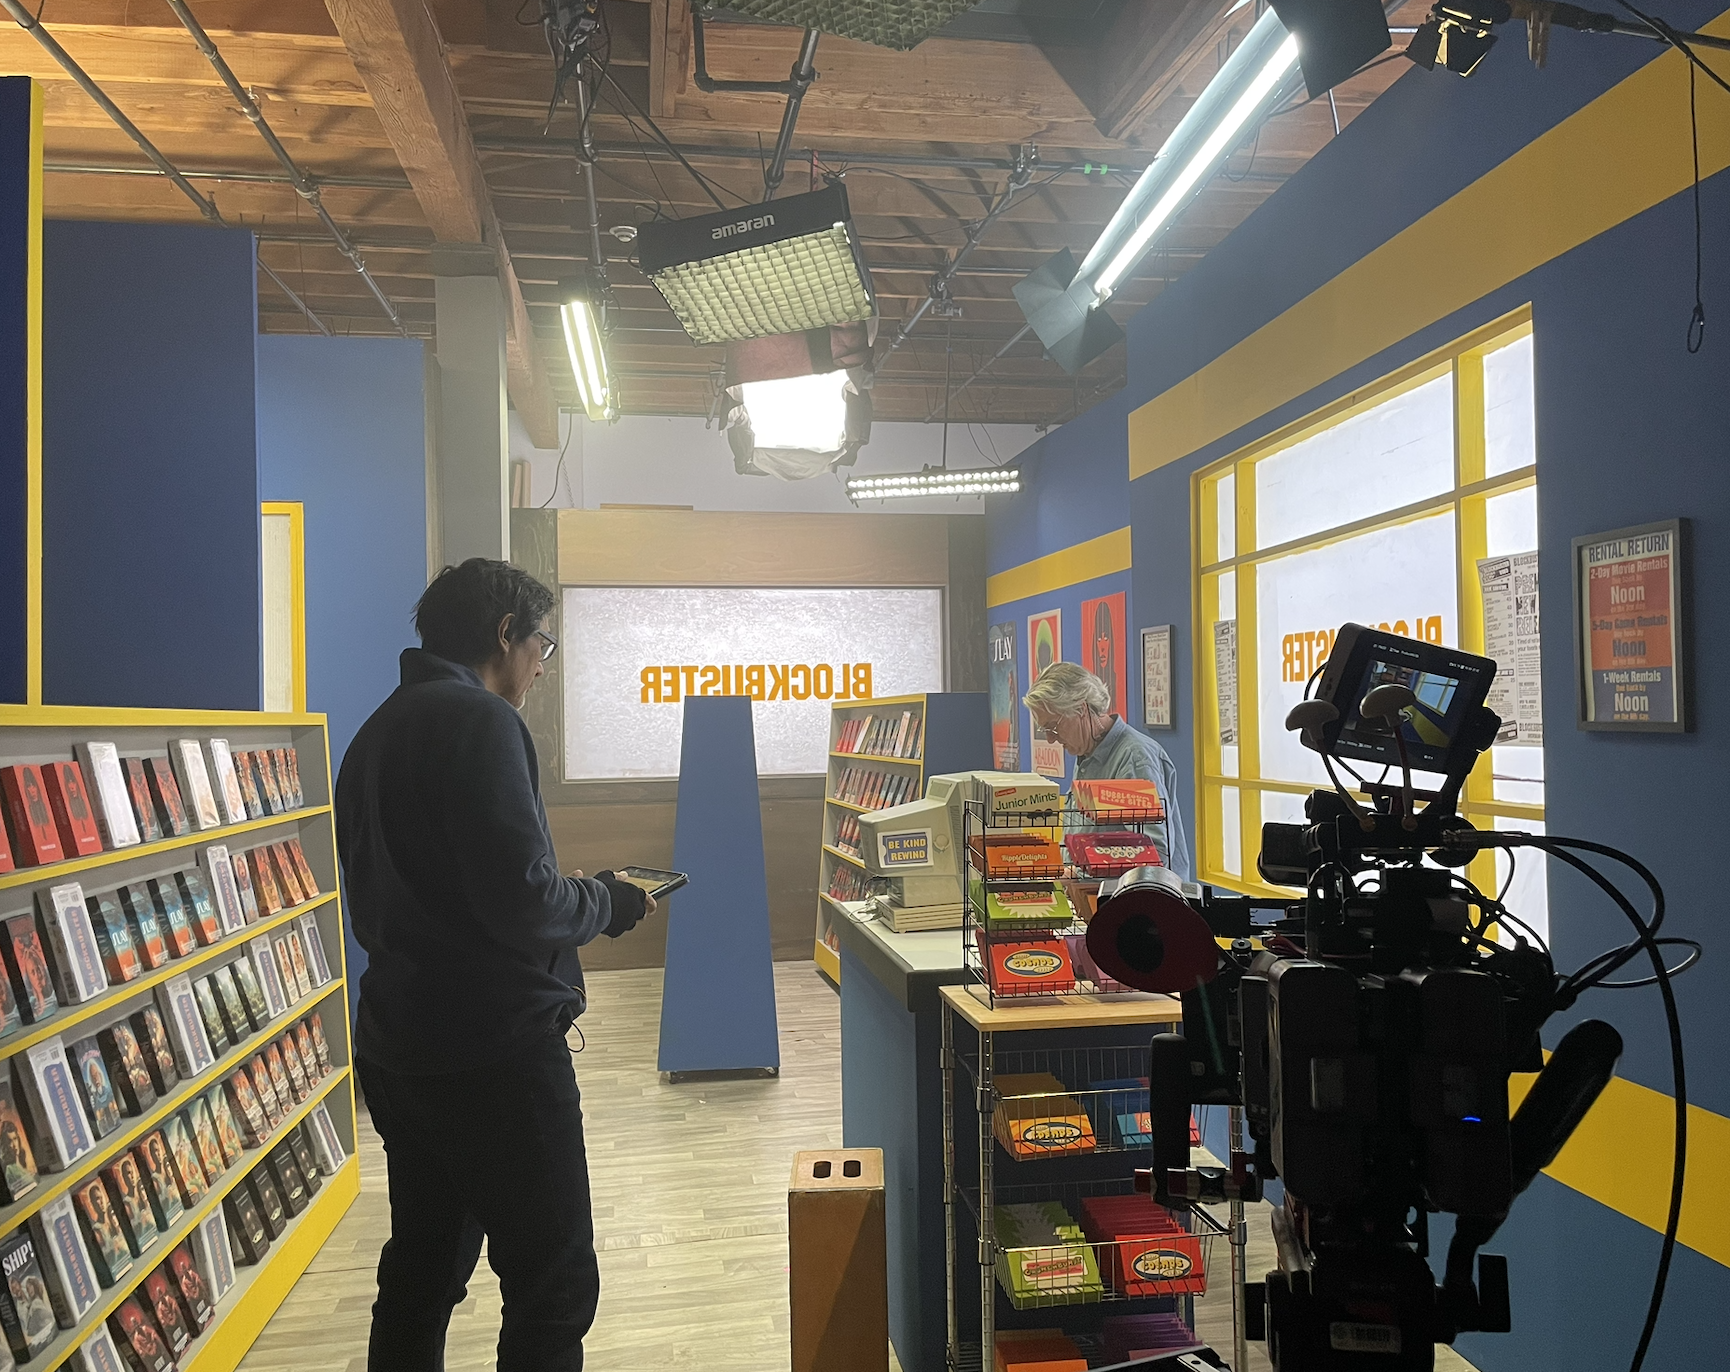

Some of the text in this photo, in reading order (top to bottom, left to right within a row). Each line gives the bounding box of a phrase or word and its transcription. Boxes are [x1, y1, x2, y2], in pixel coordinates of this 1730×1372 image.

[711, 214, 775, 240] amaran
[1589, 533, 1669, 563] RENTAL RETURN
[1590, 557, 1668, 580] 2-Day Movie Rentals
[1610, 585, 1645, 604] Noon
[993, 635, 1014, 663] SLAY
[1613, 639, 1646, 657] Noon
[1603, 669, 1662, 684] 1-Week Rentals
[1614, 693, 1649, 712] Noon
[995, 798, 1028, 811] Junior
[1029, 792, 1058, 805] Mints
[888, 838, 926, 849] BE KIND
[890, 850, 926, 861] REWIND
[141, 919, 157, 934] SLAY
[169, 909, 184, 925] SLAY
[111, 930, 128, 946] SLAY
[1012, 957, 1054, 968] COSMOS
[50, 1067, 80, 1146] BLOCKBUSTER
[2, 1240, 35, 1277] SHIP!
